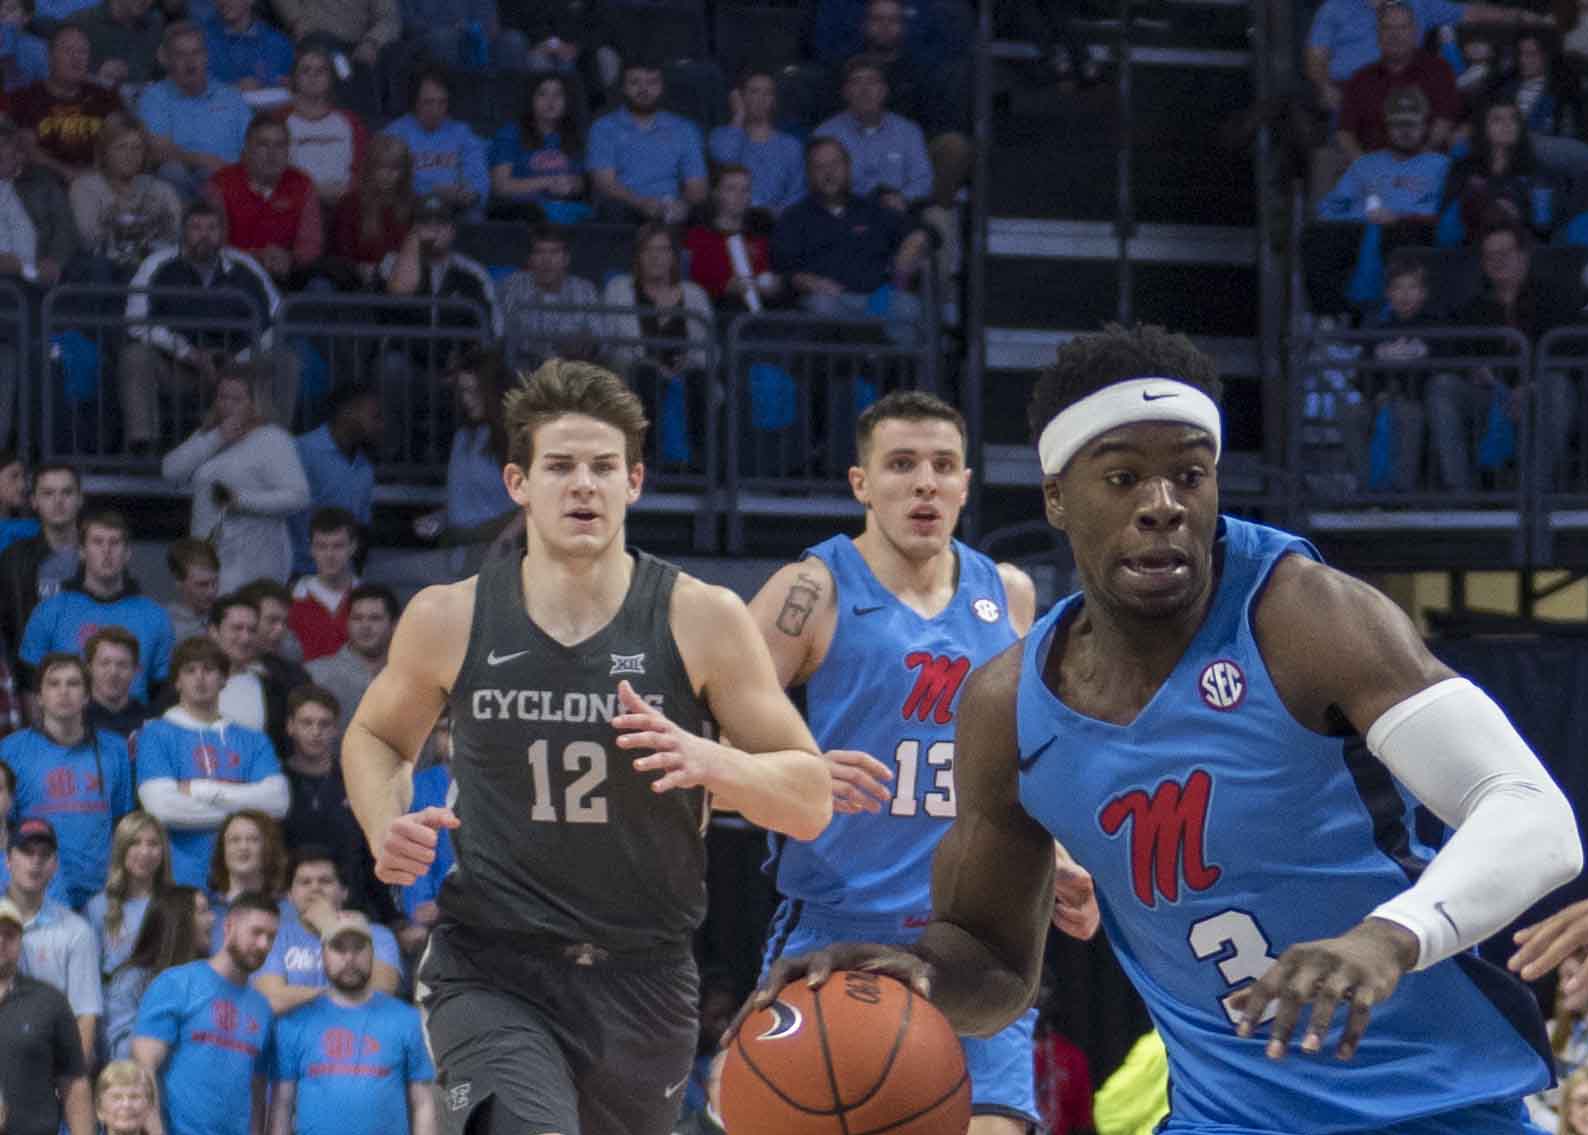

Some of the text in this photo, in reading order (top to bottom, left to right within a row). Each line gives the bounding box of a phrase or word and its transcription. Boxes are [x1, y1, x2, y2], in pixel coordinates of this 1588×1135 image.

[904, 651, 970, 725] M
[1201, 662, 1243, 708] SEC
[528, 739, 608, 823] 12
[890, 740, 957, 817] 13
[1099, 768, 1222, 908] M
[1187, 908, 1284, 1028] 3
